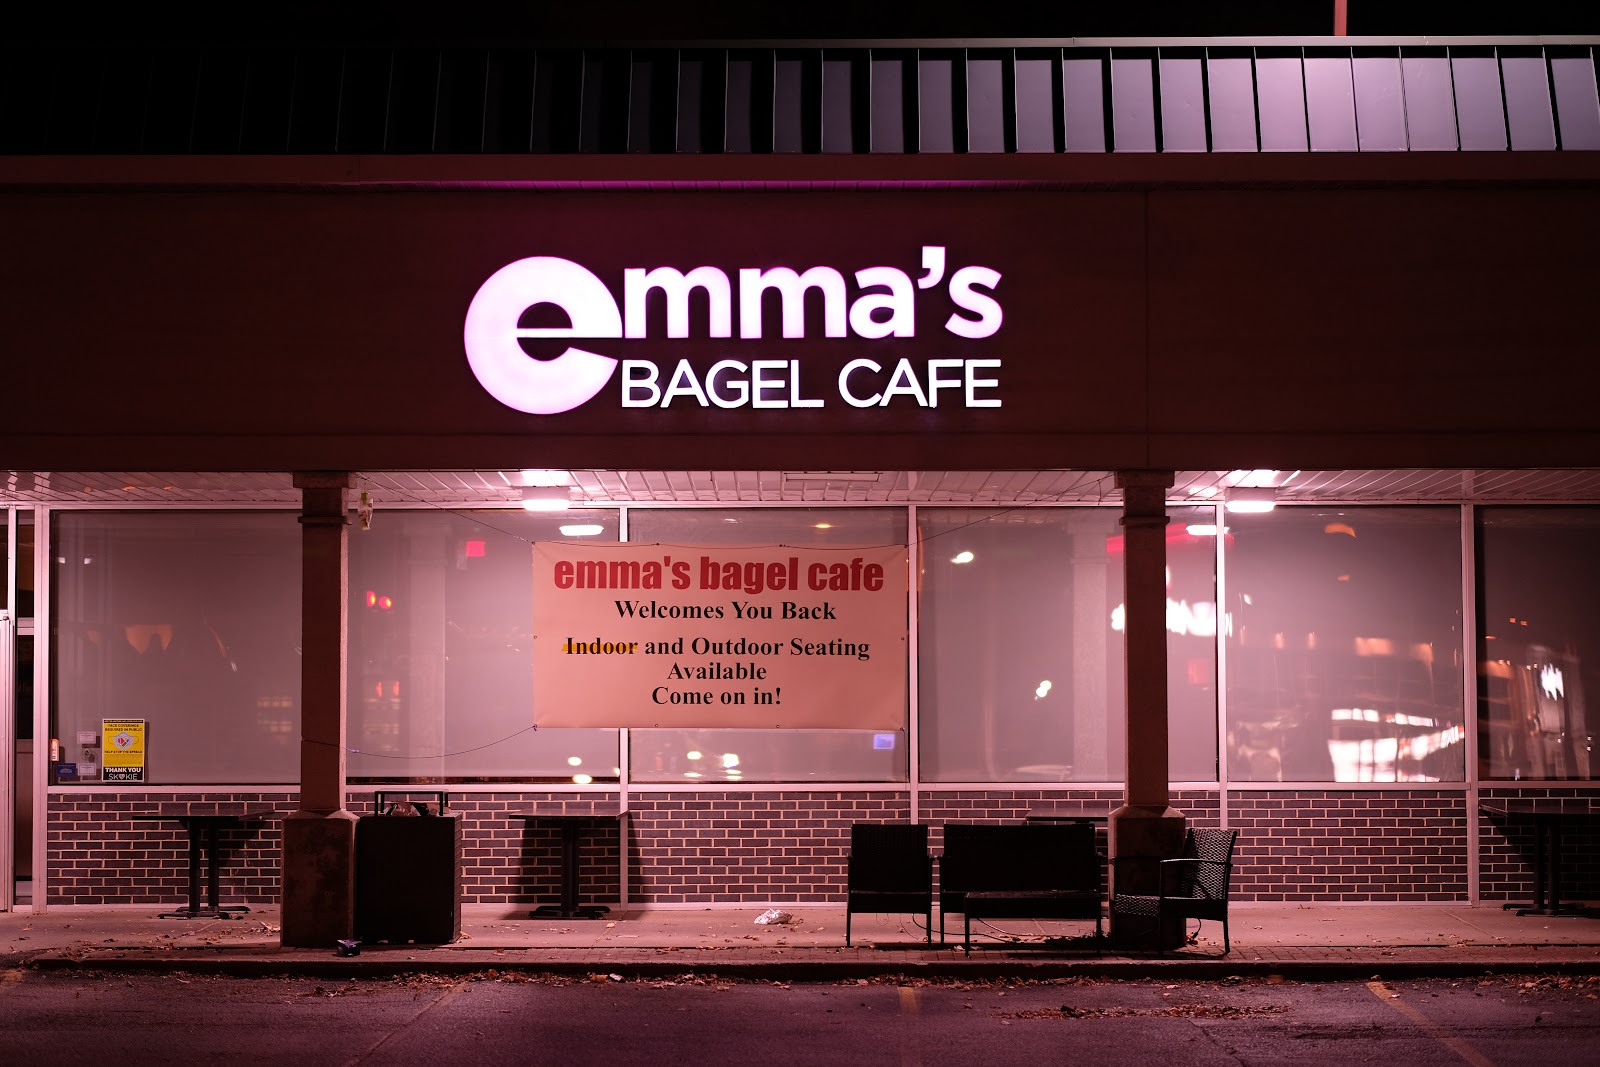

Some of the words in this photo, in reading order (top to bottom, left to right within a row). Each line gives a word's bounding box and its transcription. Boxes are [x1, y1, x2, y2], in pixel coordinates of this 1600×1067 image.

[621, 358, 825, 409] BAGEL
[837, 358, 1002, 409] CAFE
[554, 556, 691, 590] emma's
[699, 556, 799, 594] bagel
[807, 558, 884, 592] cafe
[615, 600, 725, 620] Welcomes
[731, 601, 773, 620] You
[780, 601, 837, 621] Back
[565, 637, 638, 655] Indoor
[644, 638, 684, 655] and
[691, 637, 784, 656] Outdoor
[790, 638, 870, 661] Seating
[667, 662, 767, 680] Available
[651, 687, 714, 705] Come
[720, 692, 746, 705] on
[753, 687, 781, 705] in!
